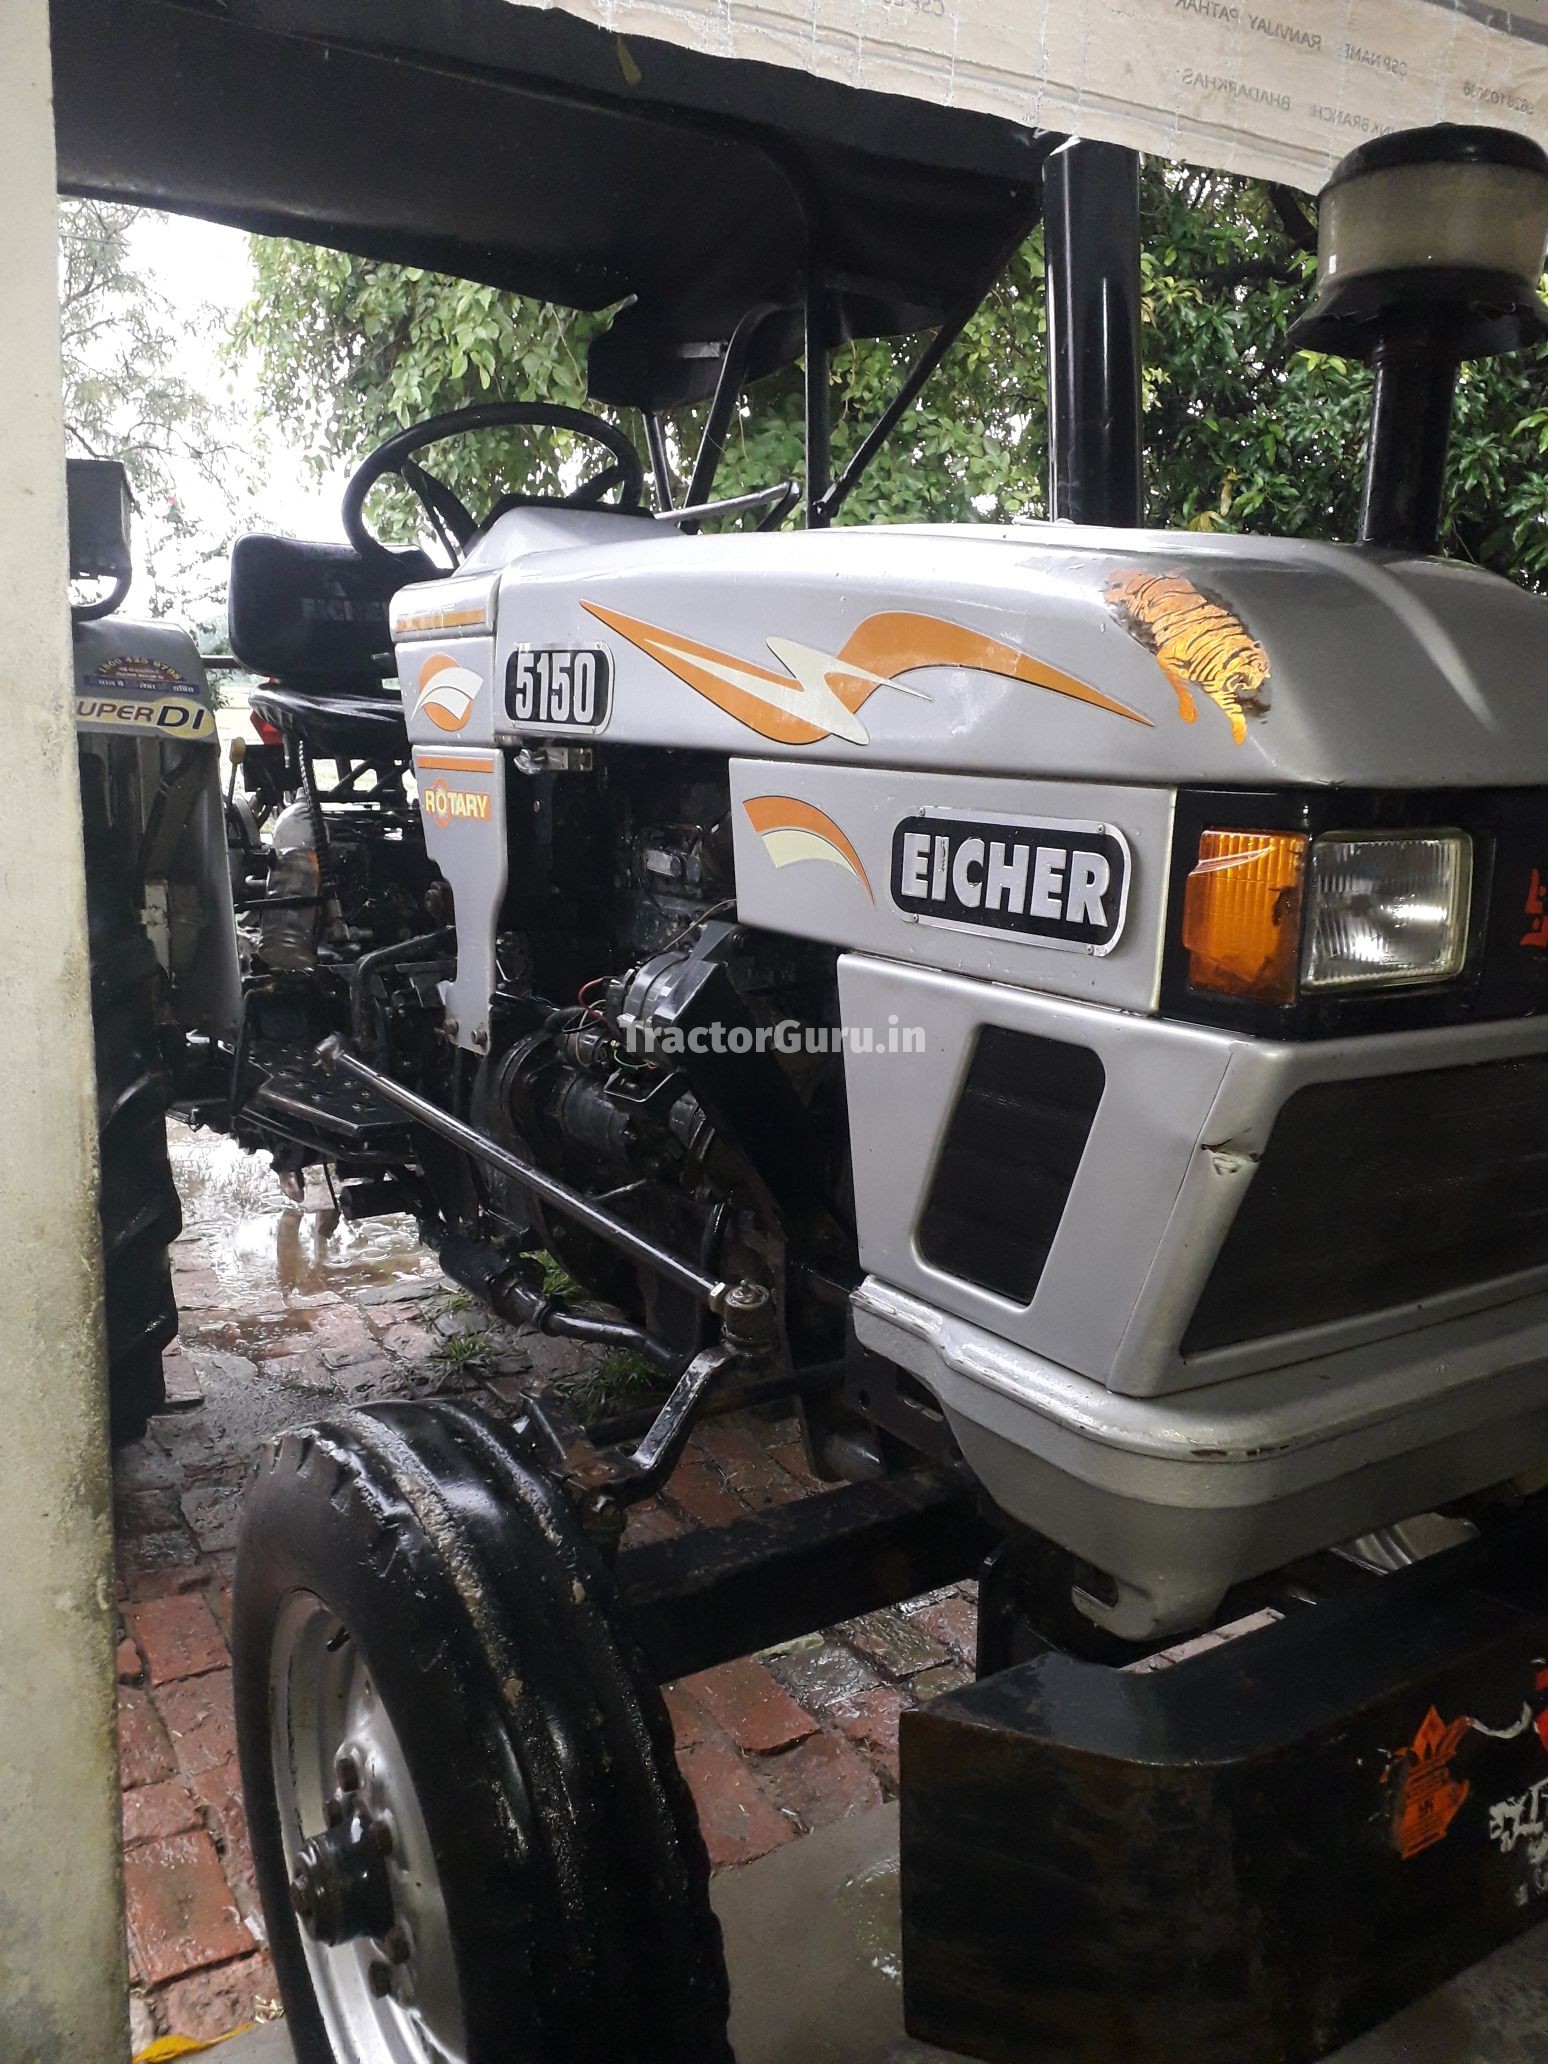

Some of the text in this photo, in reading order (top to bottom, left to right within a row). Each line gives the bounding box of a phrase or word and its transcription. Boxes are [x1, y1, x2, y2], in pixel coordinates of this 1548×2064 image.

[515, 652, 596, 723] 5150
[156, 705, 205, 730] DI
[424, 787, 489, 819] ROTARY
[901, 832, 1109, 928] EICHER
